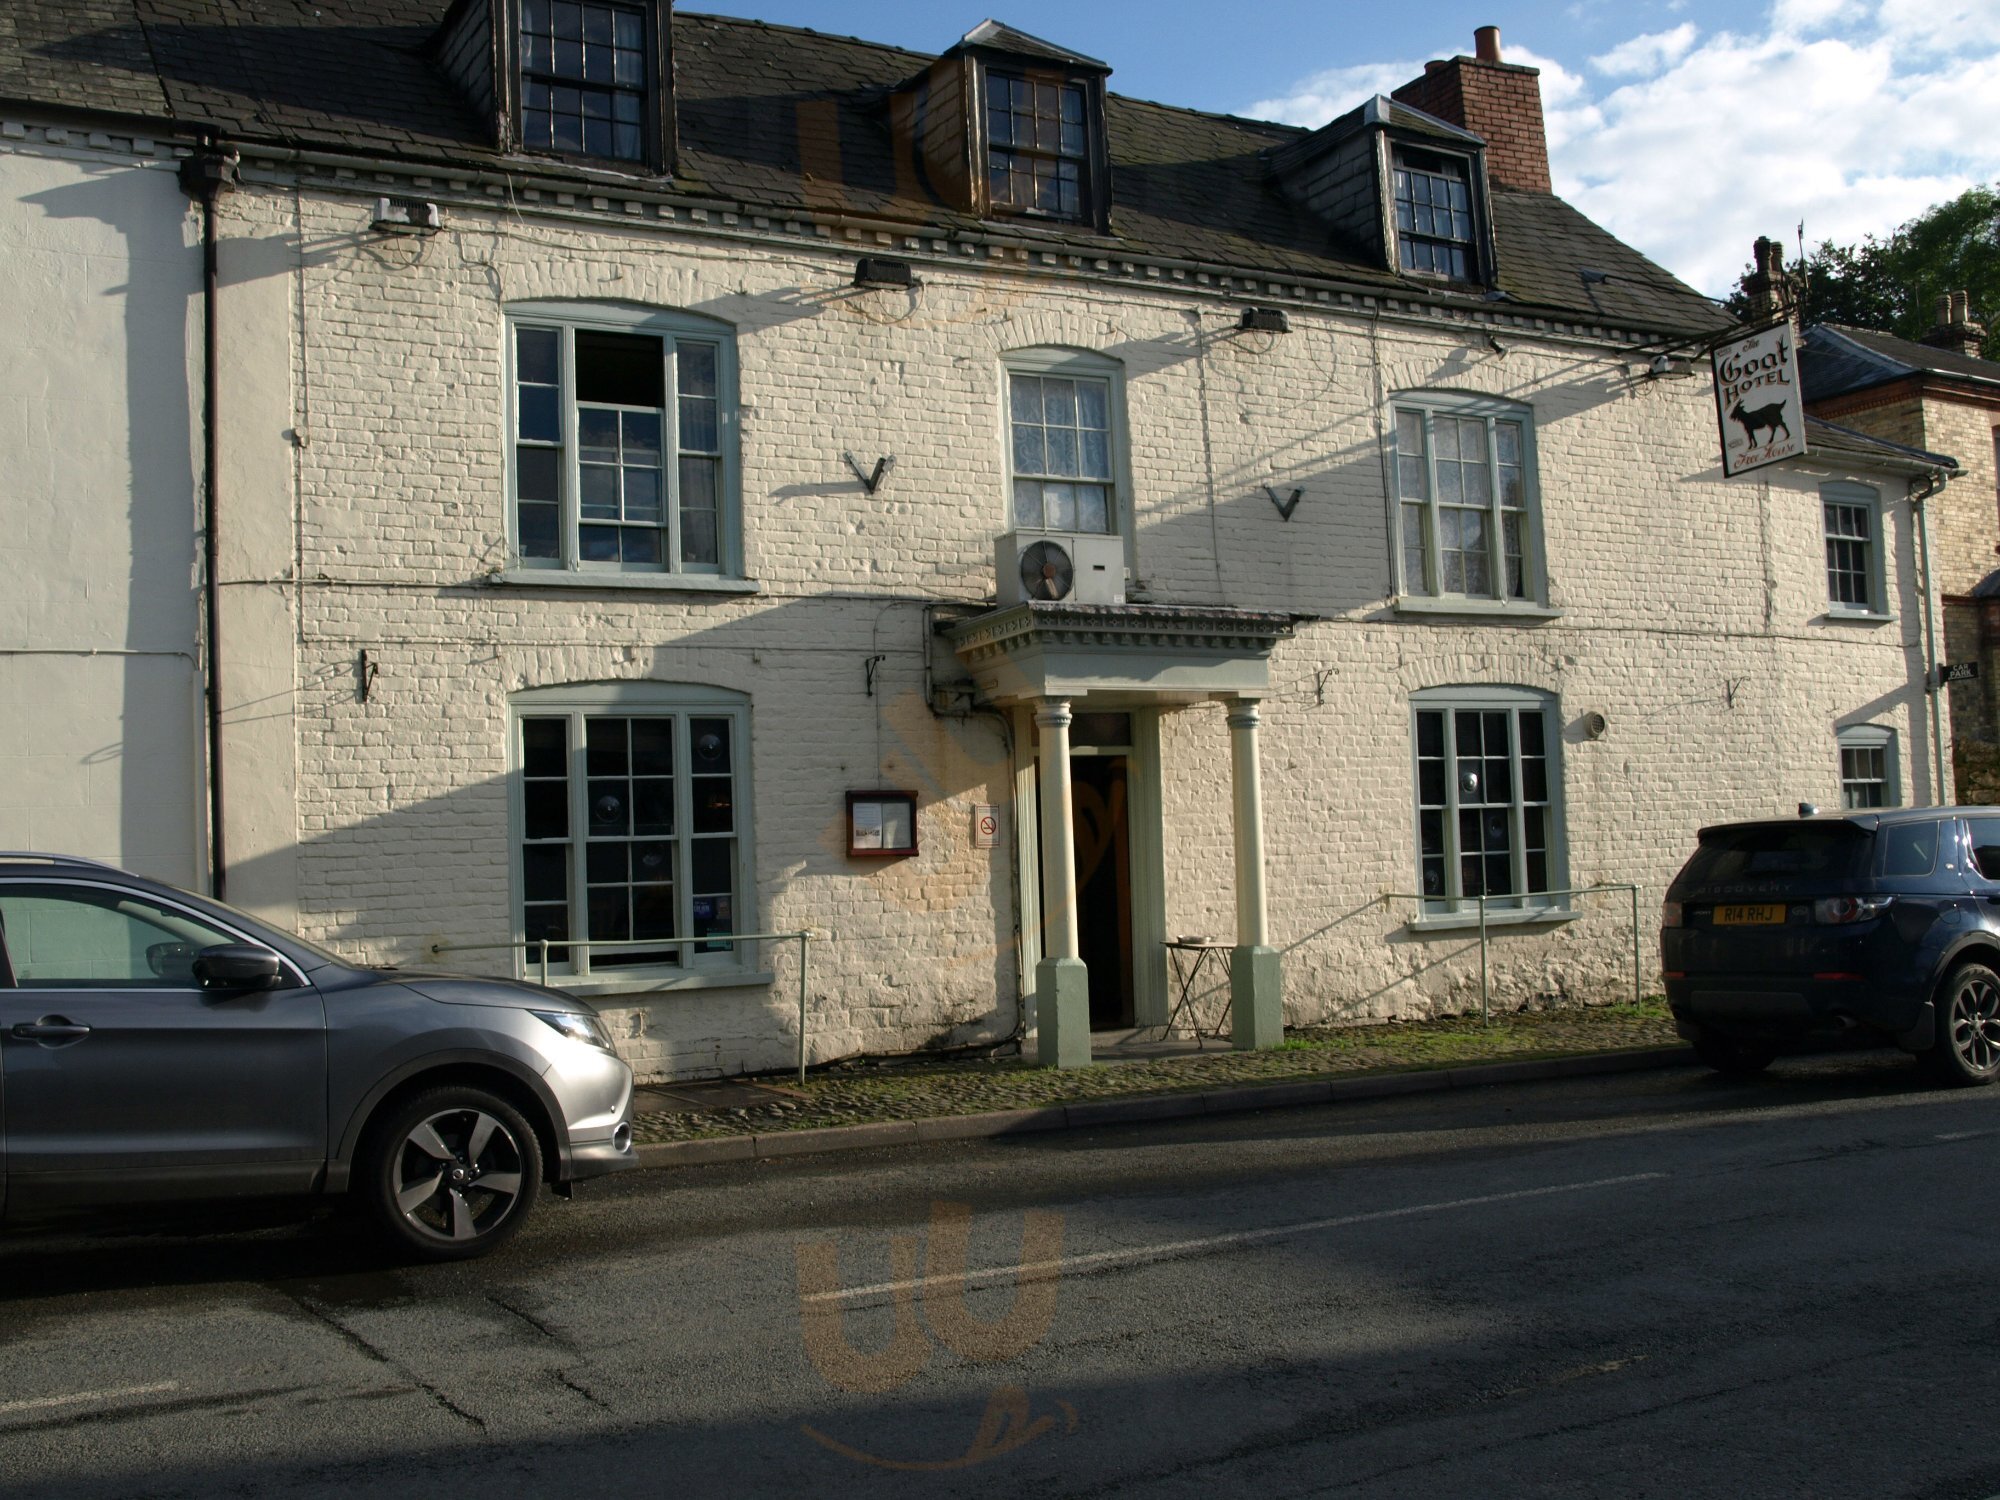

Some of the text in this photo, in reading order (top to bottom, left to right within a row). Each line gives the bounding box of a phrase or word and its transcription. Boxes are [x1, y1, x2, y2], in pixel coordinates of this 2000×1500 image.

[1719, 334, 1788, 384] Goat
[1723, 369, 1791, 410] HOTEL
[1733, 443, 1795, 470] Free House
[1950, 669, 1971, 679] PARK
[1696, 883, 1793, 893] DISCOVERY
[1724, 905, 1774, 922] R14 RHJ
